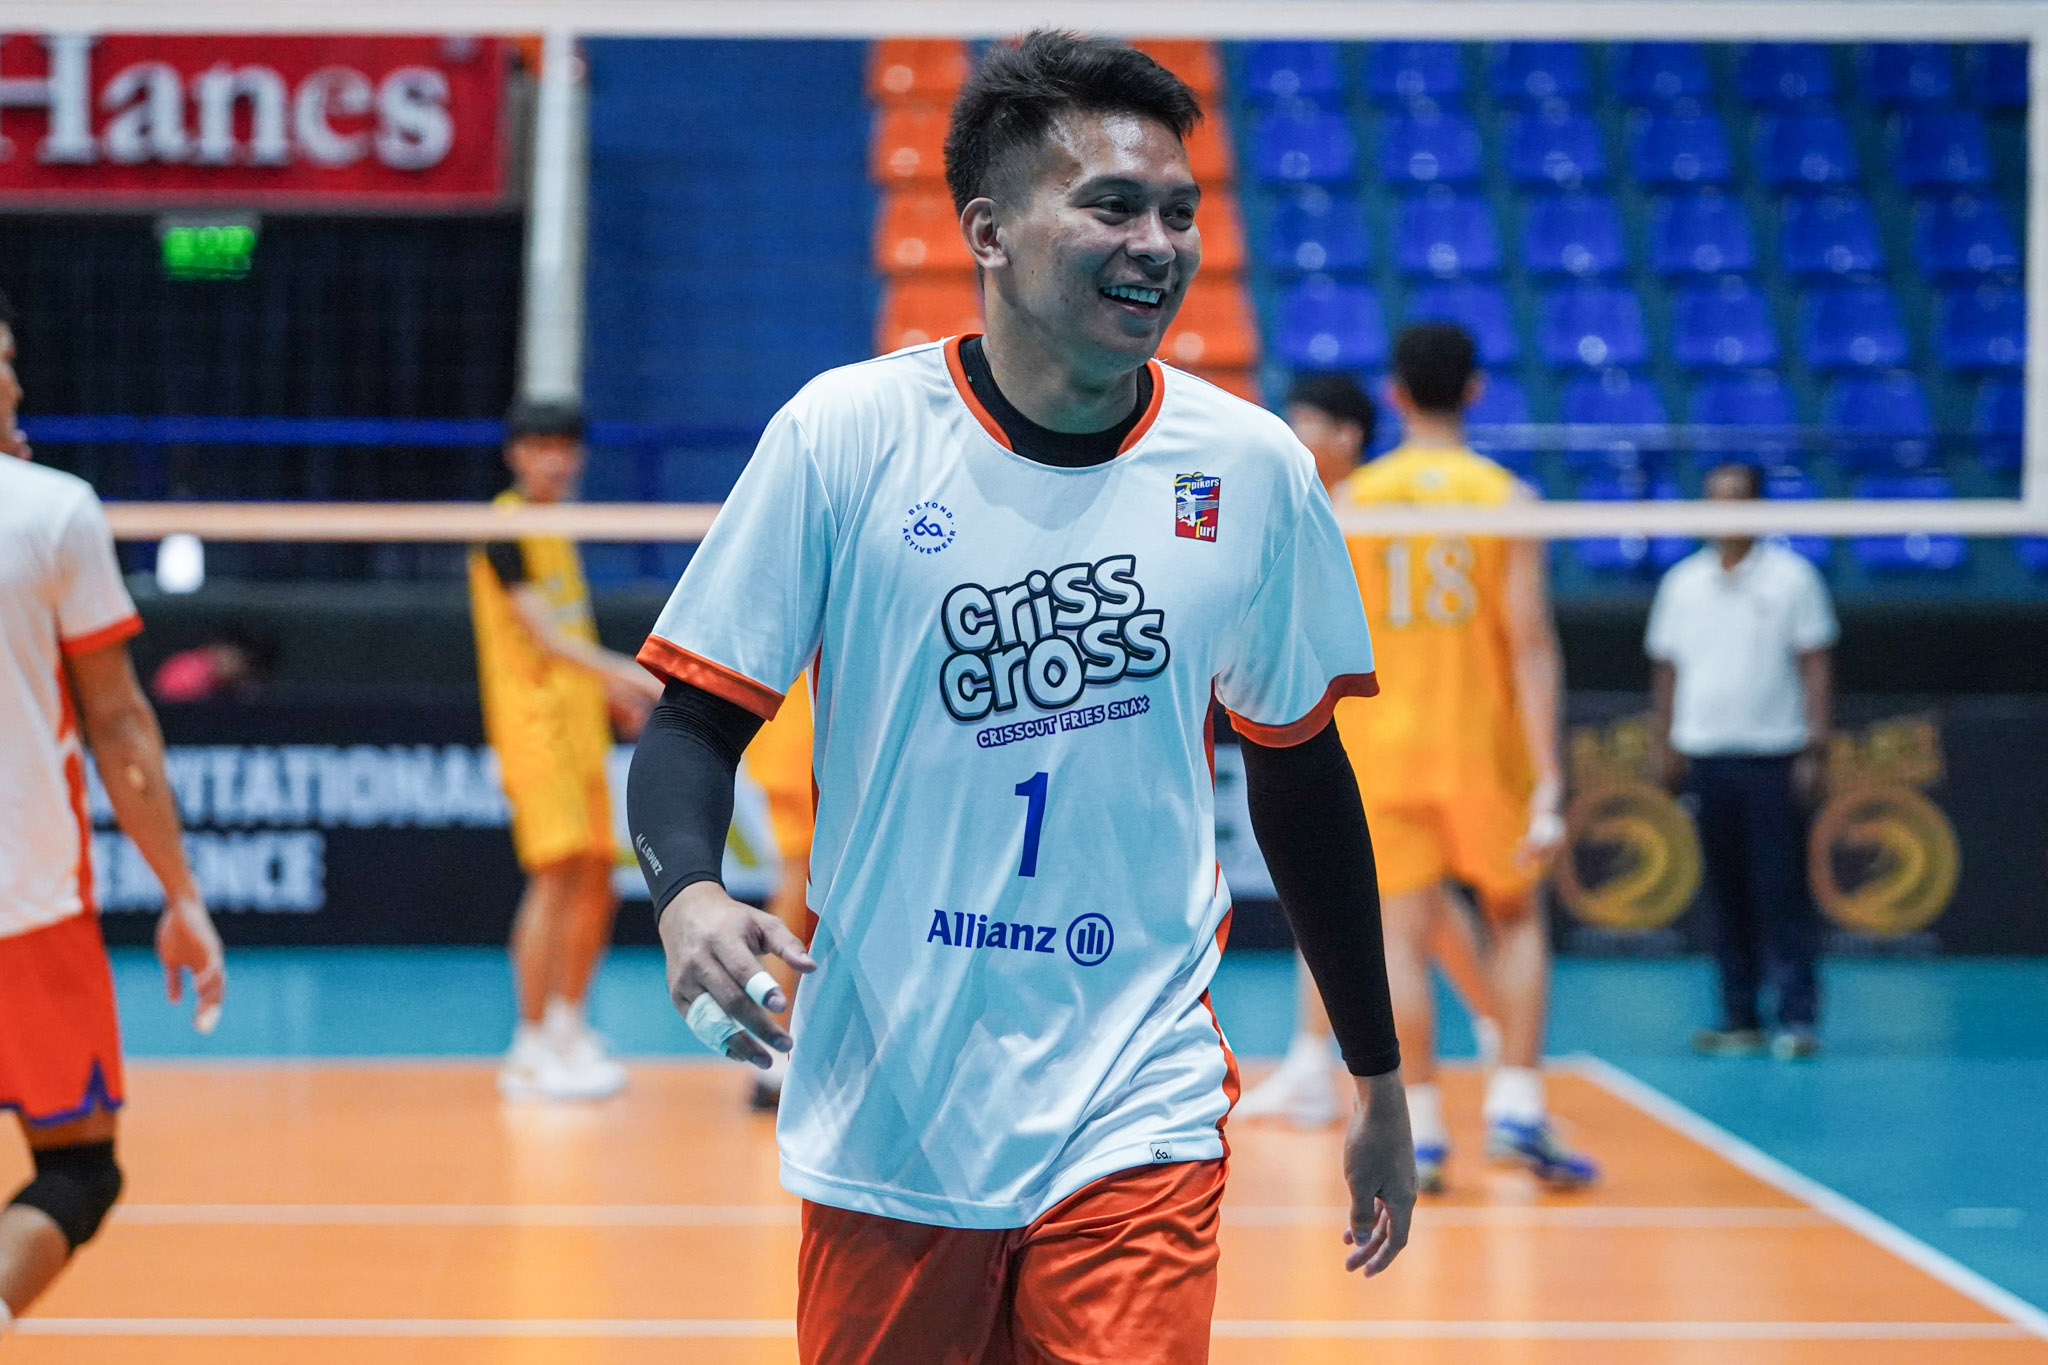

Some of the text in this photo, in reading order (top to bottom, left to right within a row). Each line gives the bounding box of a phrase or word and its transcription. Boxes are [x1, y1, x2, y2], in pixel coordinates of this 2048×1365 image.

[908, 501, 953, 519] BEYOND
[1195, 516, 1216, 538] Turf
[902, 527, 956, 555] ACTIVEWEAR
[1386, 536, 1482, 628] 18
[977, 695, 1150, 748] CRISSCUT FRIES SNAX
[1014, 771, 1049, 878] 1
[927, 909, 1057, 954] Allianz
